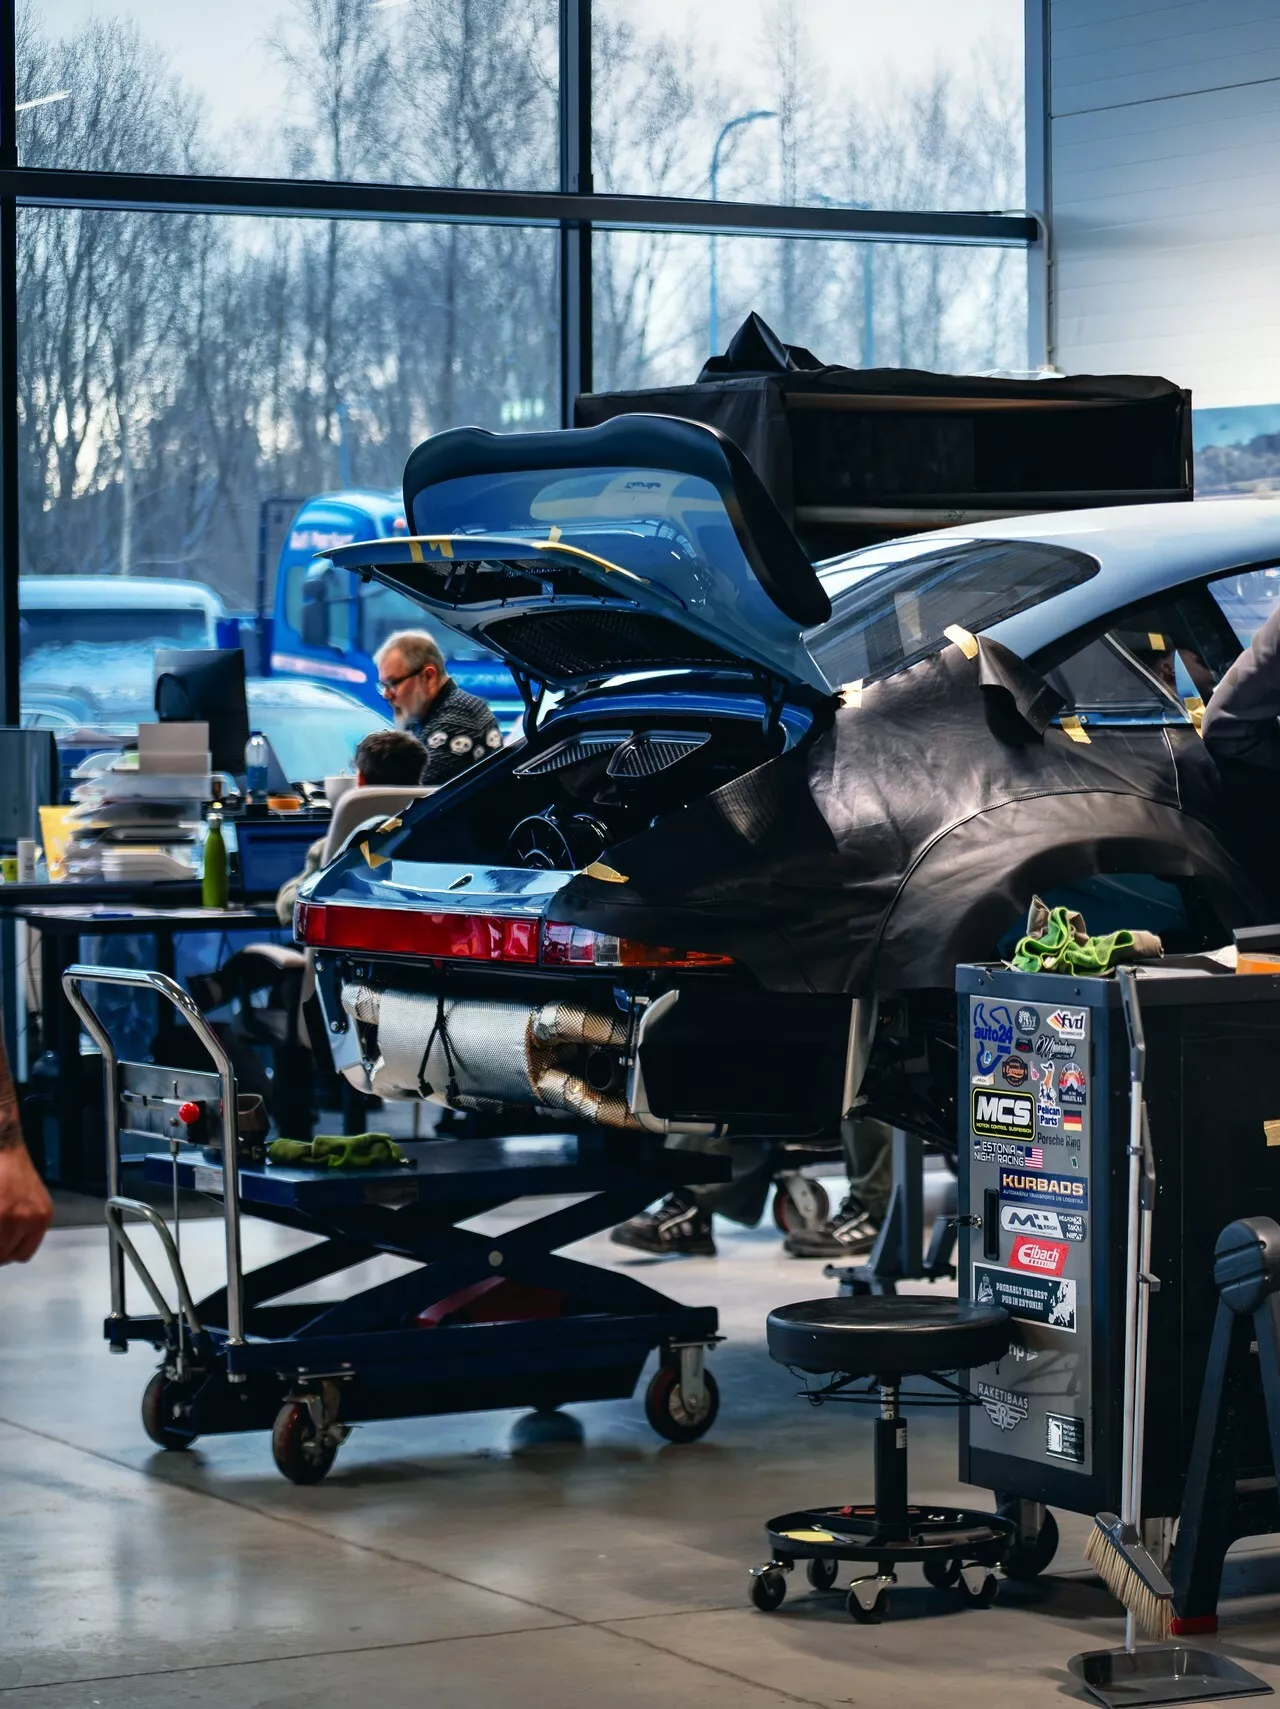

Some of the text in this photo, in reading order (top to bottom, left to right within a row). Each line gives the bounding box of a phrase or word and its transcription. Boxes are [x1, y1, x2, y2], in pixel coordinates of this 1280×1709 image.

[1061, 1012, 1085, 1030] fvd
[974, 1024, 1013, 1044] auto24
[976, 1095, 1032, 1126] MCS
[1037, 1104, 1061, 1115] Pelican
[1040, 1115, 1058, 1126] Parts
[982, 1141, 1016, 1154] ESTONIA
[1037, 1132, 1081, 1151] Porsche Ring
[974, 1151, 1024, 1167] NIGHT RACING
[1002, 1174, 1084, 1197] KURBADS
[1018, 1243, 1060, 1267] Eibach
[996, 1282, 1048, 1300] PROBABLY THE BEST
[1002, 1295, 1012, 1304] PUB
[1012, 1297, 1019, 1305] IN
[978, 1383, 1028, 1409] RAKETIBAAS
